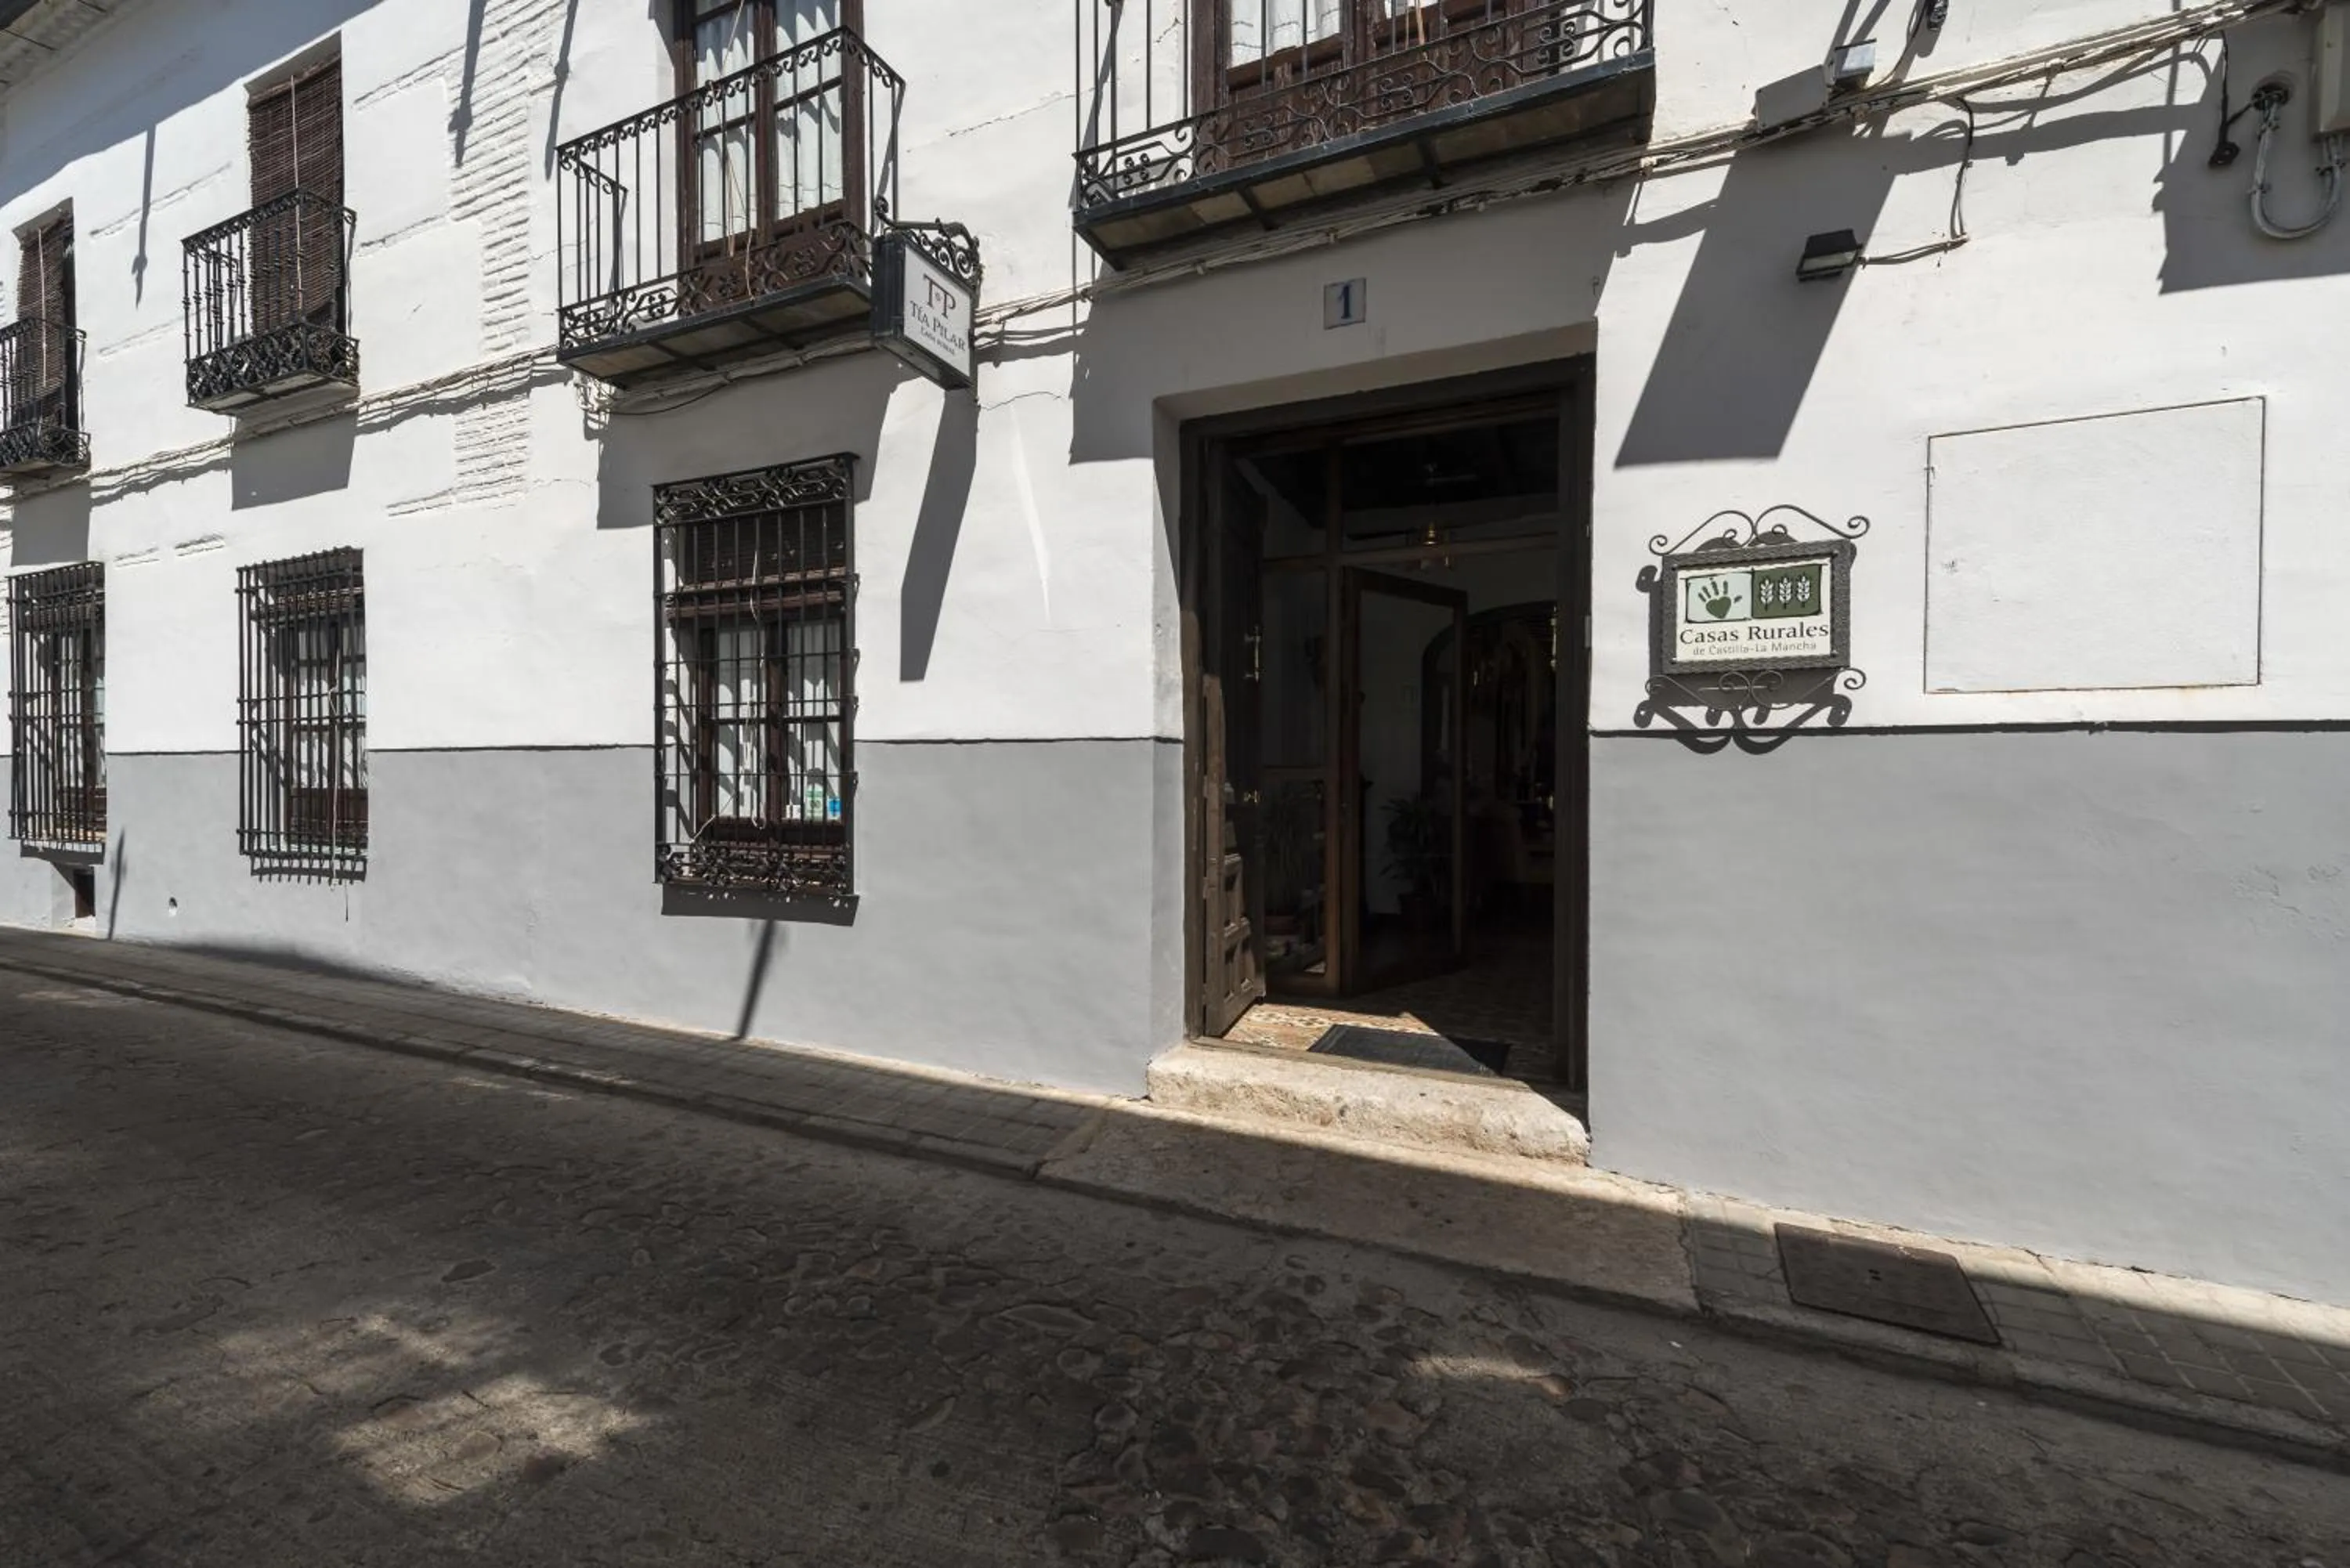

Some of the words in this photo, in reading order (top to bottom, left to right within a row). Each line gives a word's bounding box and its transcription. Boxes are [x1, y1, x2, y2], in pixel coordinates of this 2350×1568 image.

[1337, 283, 1352, 320] 1
[933, 316, 965, 351] PILAR
[1680, 629, 1739, 645] Casas
[1748, 621, 1829, 641] Rurales
[1693, 647, 1705, 656] de
[1708, 643, 1767, 655] Castilla-La
[1771, 641, 1817, 652] Mancha
